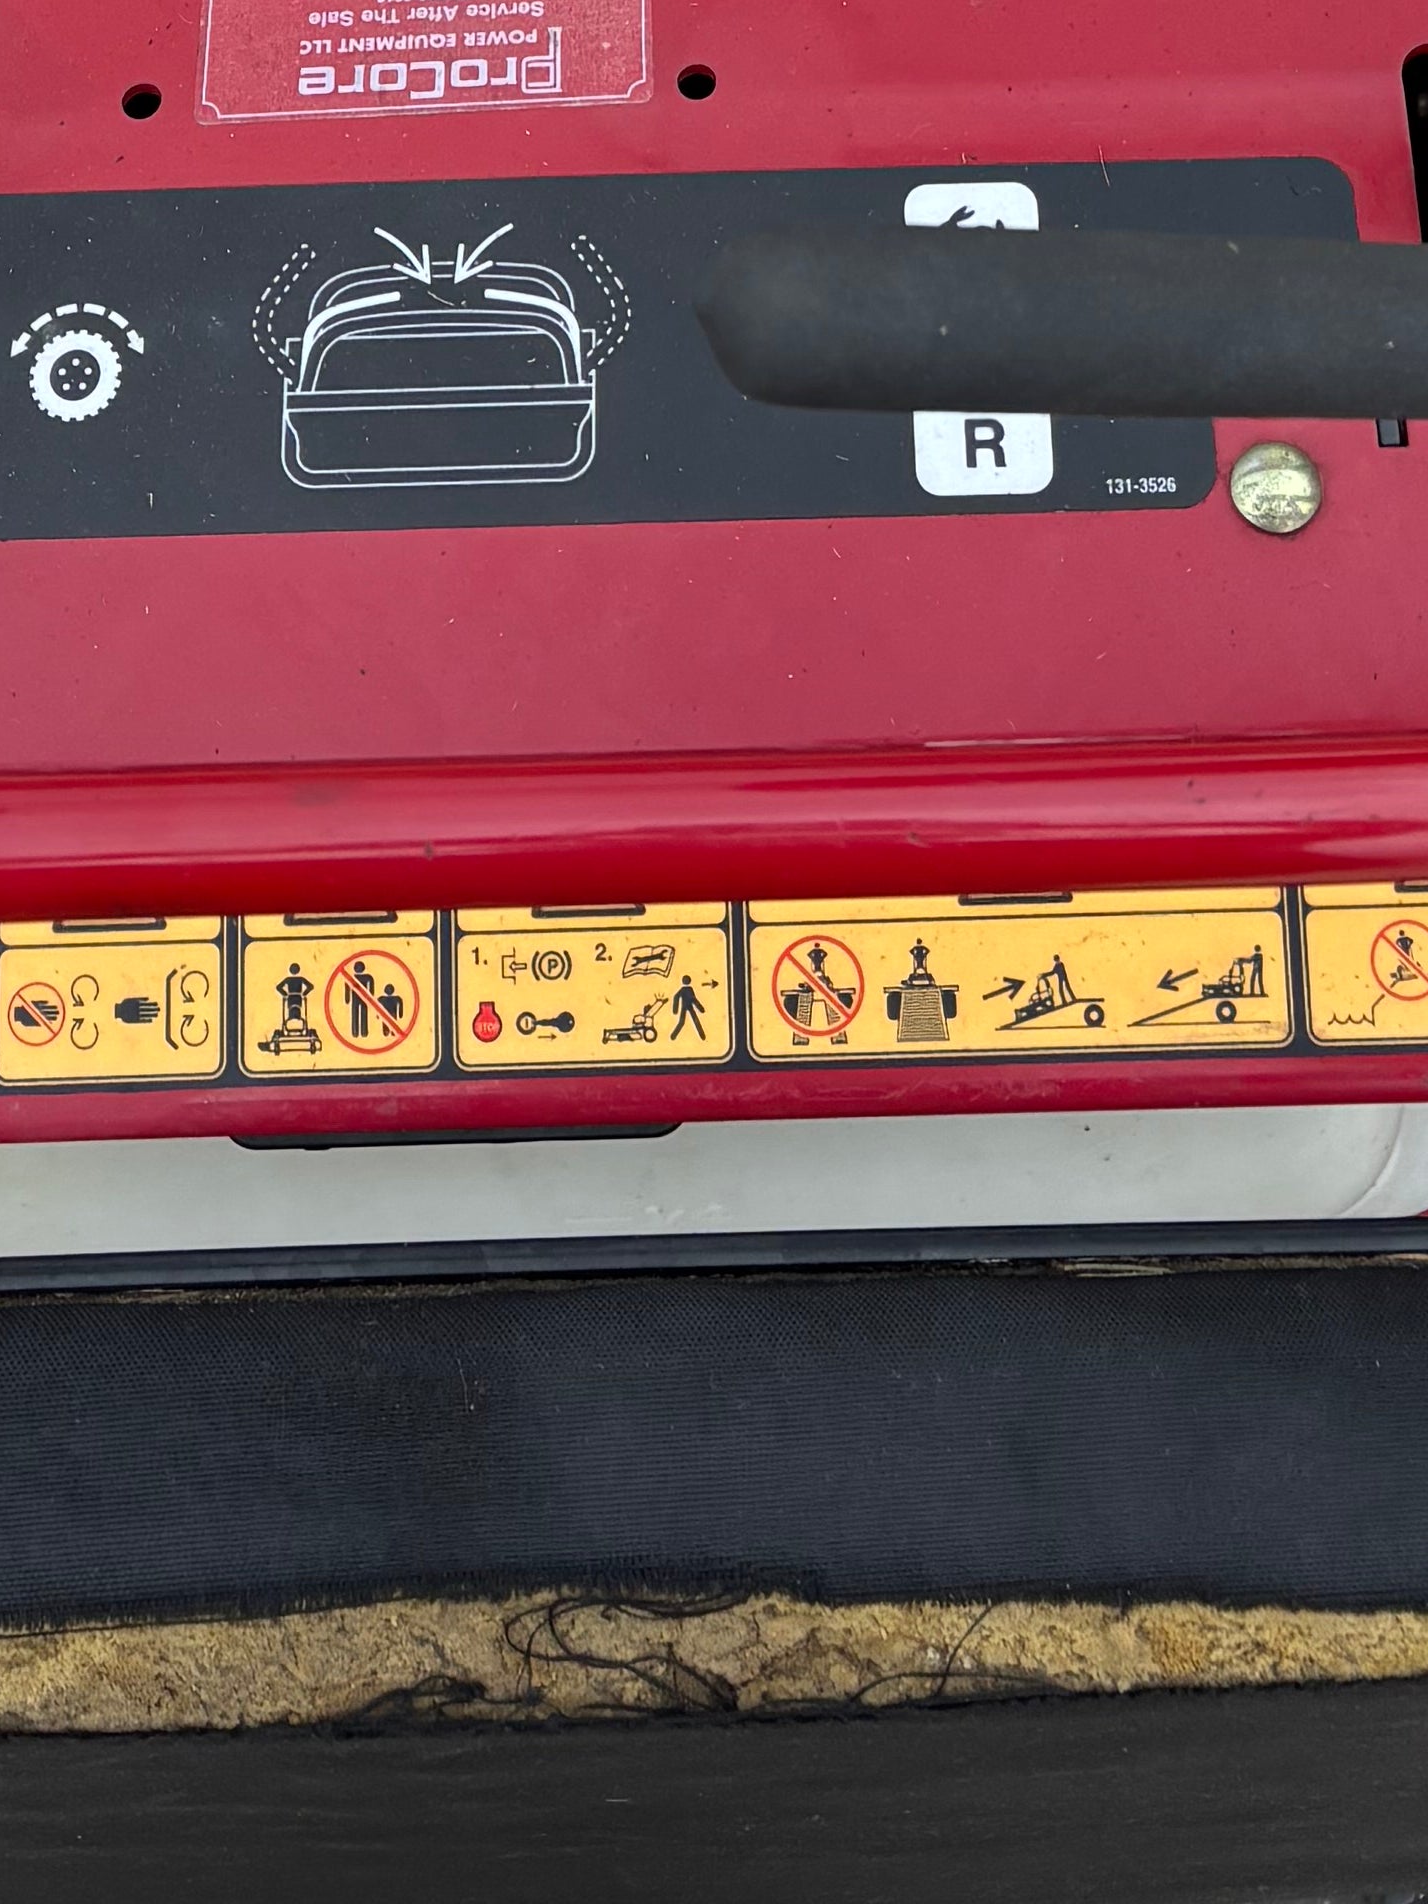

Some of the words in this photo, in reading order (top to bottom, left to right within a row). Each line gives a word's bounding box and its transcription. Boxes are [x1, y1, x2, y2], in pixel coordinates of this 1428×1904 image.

[361, 7, 400, 25] The
[407, 4, 459, 22] After
[466, 0, 545, 17] Service
[308, 10, 355, 28] Sale
[337, 33, 457, 53] EQUIPMENT
[464, 29, 538, 47] POWER
[299, 39, 332, 56] LLC
[298, 25, 563, 100] ProCore
[963, 417, 1008, 469] R
[1104, 477, 1177, 495] 131-3526
[471, 946, 489, 966] 1.
[594, 942, 614, 962] 2.
